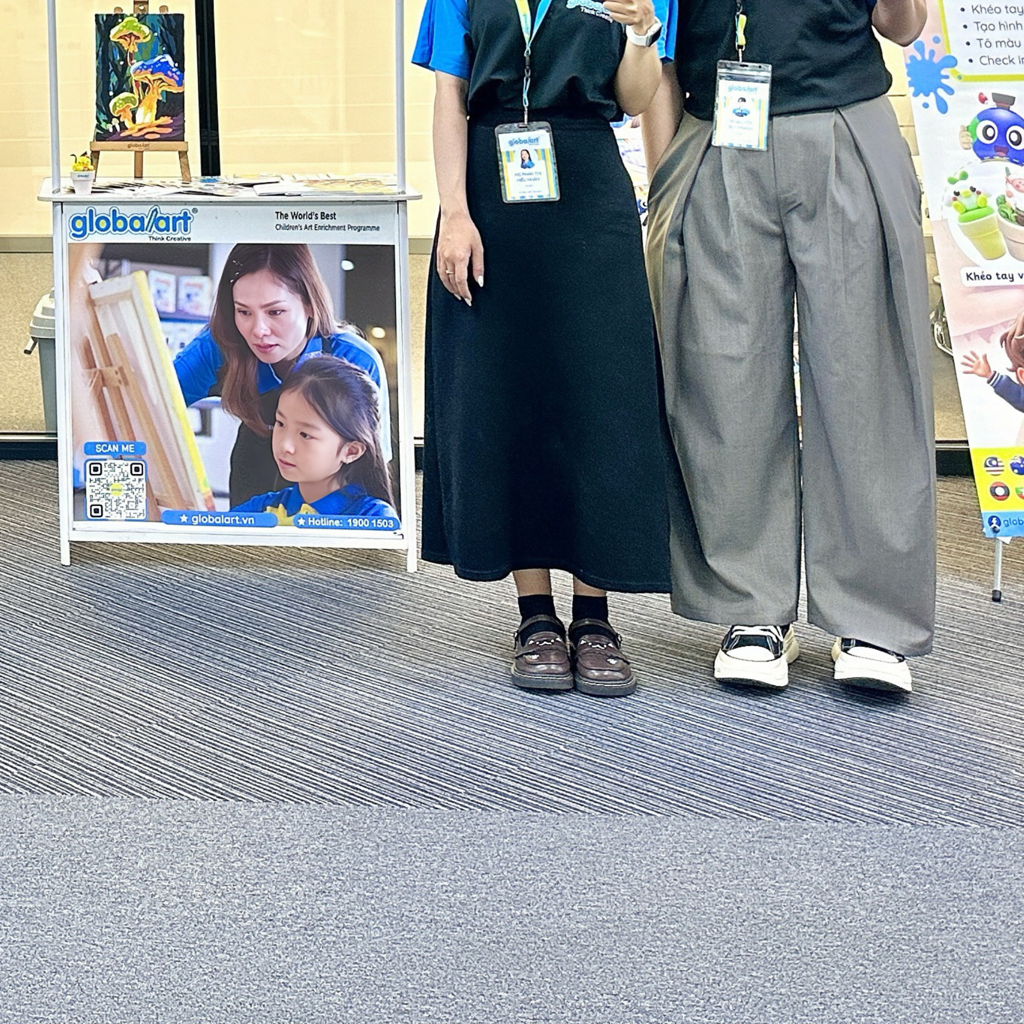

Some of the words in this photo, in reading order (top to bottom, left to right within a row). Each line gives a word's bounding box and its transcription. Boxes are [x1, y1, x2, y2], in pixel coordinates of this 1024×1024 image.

[971, 4, 1002, 15] Khéo
[974, 21, 996, 33] Tạo
[998, 21, 1023, 31] hình
[976, 38, 992, 49] Tô
[995, 38, 1022, 48] màu
[979, 55, 1015, 66] Check
[275, 211, 289, 220] The
[290, 211, 319, 220] World's
[320, 211, 337, 220] Best
[275, 223, 303, 232] Children's
[314, 224, 346, 232] Enrichment
[347, 224, 381, 233] Programme
[965, 271, 992, 281] Khéo
[996, 272, 1014, 282] tay
[95, 443, 119, 454] SCAN
[121, 444, 135, 454] ME
[191, 513, 255, 526] globalart.vn
[308, 517, 343, 527] Hotline:
[347, 517, 370, 528] 1900
[371, 518, 394, 529] 1503
